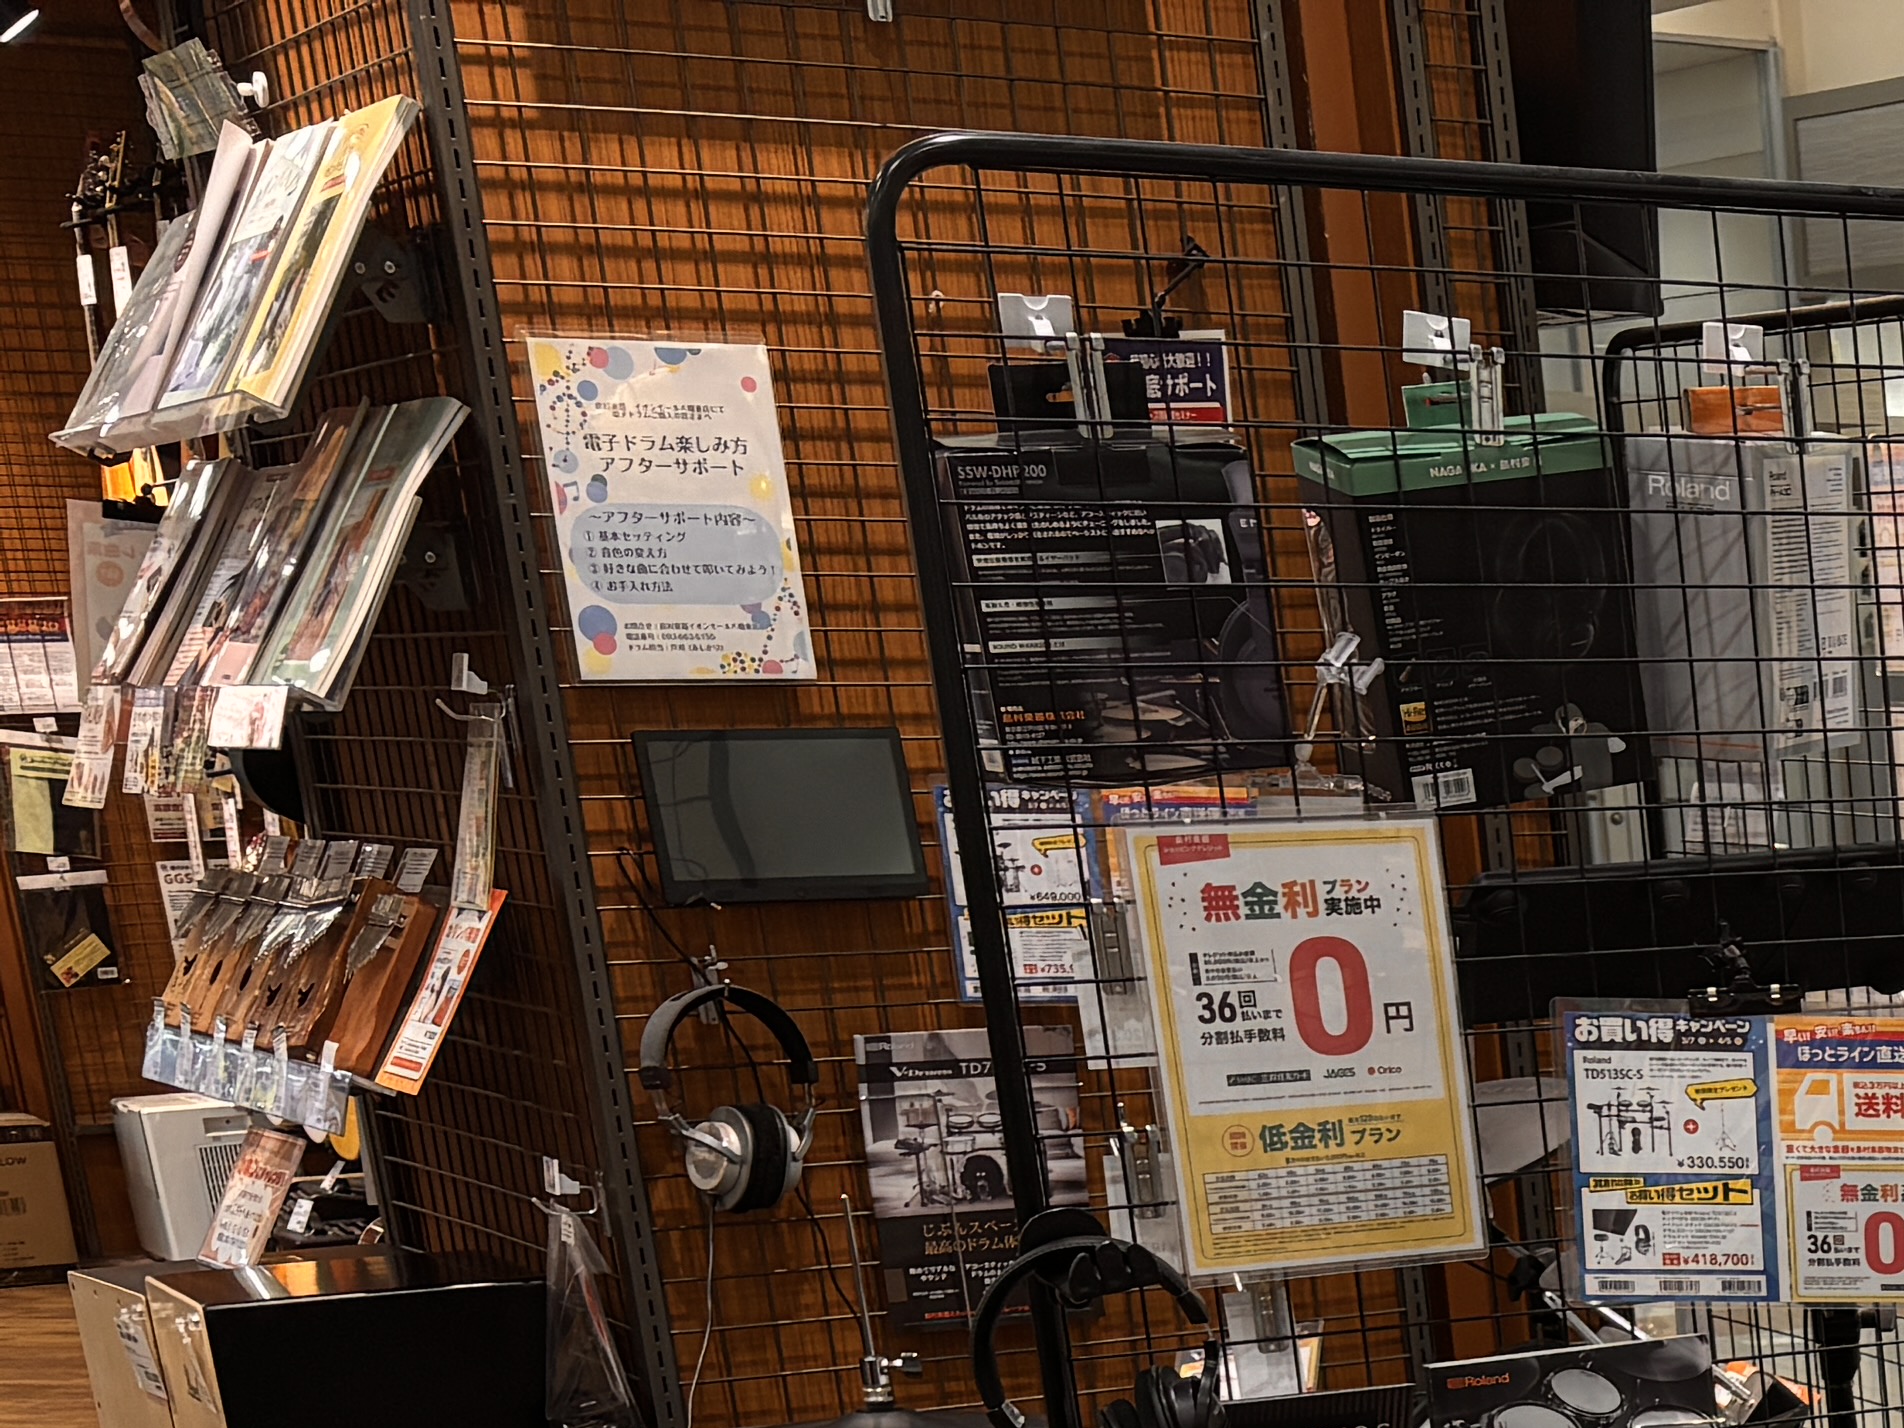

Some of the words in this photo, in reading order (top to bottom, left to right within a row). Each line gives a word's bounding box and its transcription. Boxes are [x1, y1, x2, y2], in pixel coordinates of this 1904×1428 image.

[583, 434, 748, 456] 電子ドラム楽しみ方
[599, 457, 745, 477] アフターサポート
[1647, 473, 1731, 502] Roland
[1199, 879, 1320, 924] 無金利
[1322, 879, 1370, 895] プラン
[1323, 895, 1383, 917] 実施中
[1289, 935, 1375, 1057] 0
[1383, 1001, 1415, 1035] 円
[1195, 990, 1237, 1026] 36
[1237, 989, 1258, 1009] 回
[1240, 1009, 1284, 1022] 払いまで
[1199, 1026, 1286, 1047] 分割払手数料
[1574, 1016, 1676, 1044] お買い得
[1675, 1018, 1751, 1034] キャンペーン
[1583, 1067, 1645, 1080] TD513SC-S
[1258, 1120, 1346, 1154] 低金利
[1350, 1127, 1403, 1147] プラン
[1628, 1181, 1749, 1202] お買い得セット
[1839, 1182, 1900, 1204] 無金利
[1806, 1234, 1832, 1255] 36
[1682, 1252, 1750, 1267] ¥418,700
[1463, 1371, 1511, 1389] Roland
